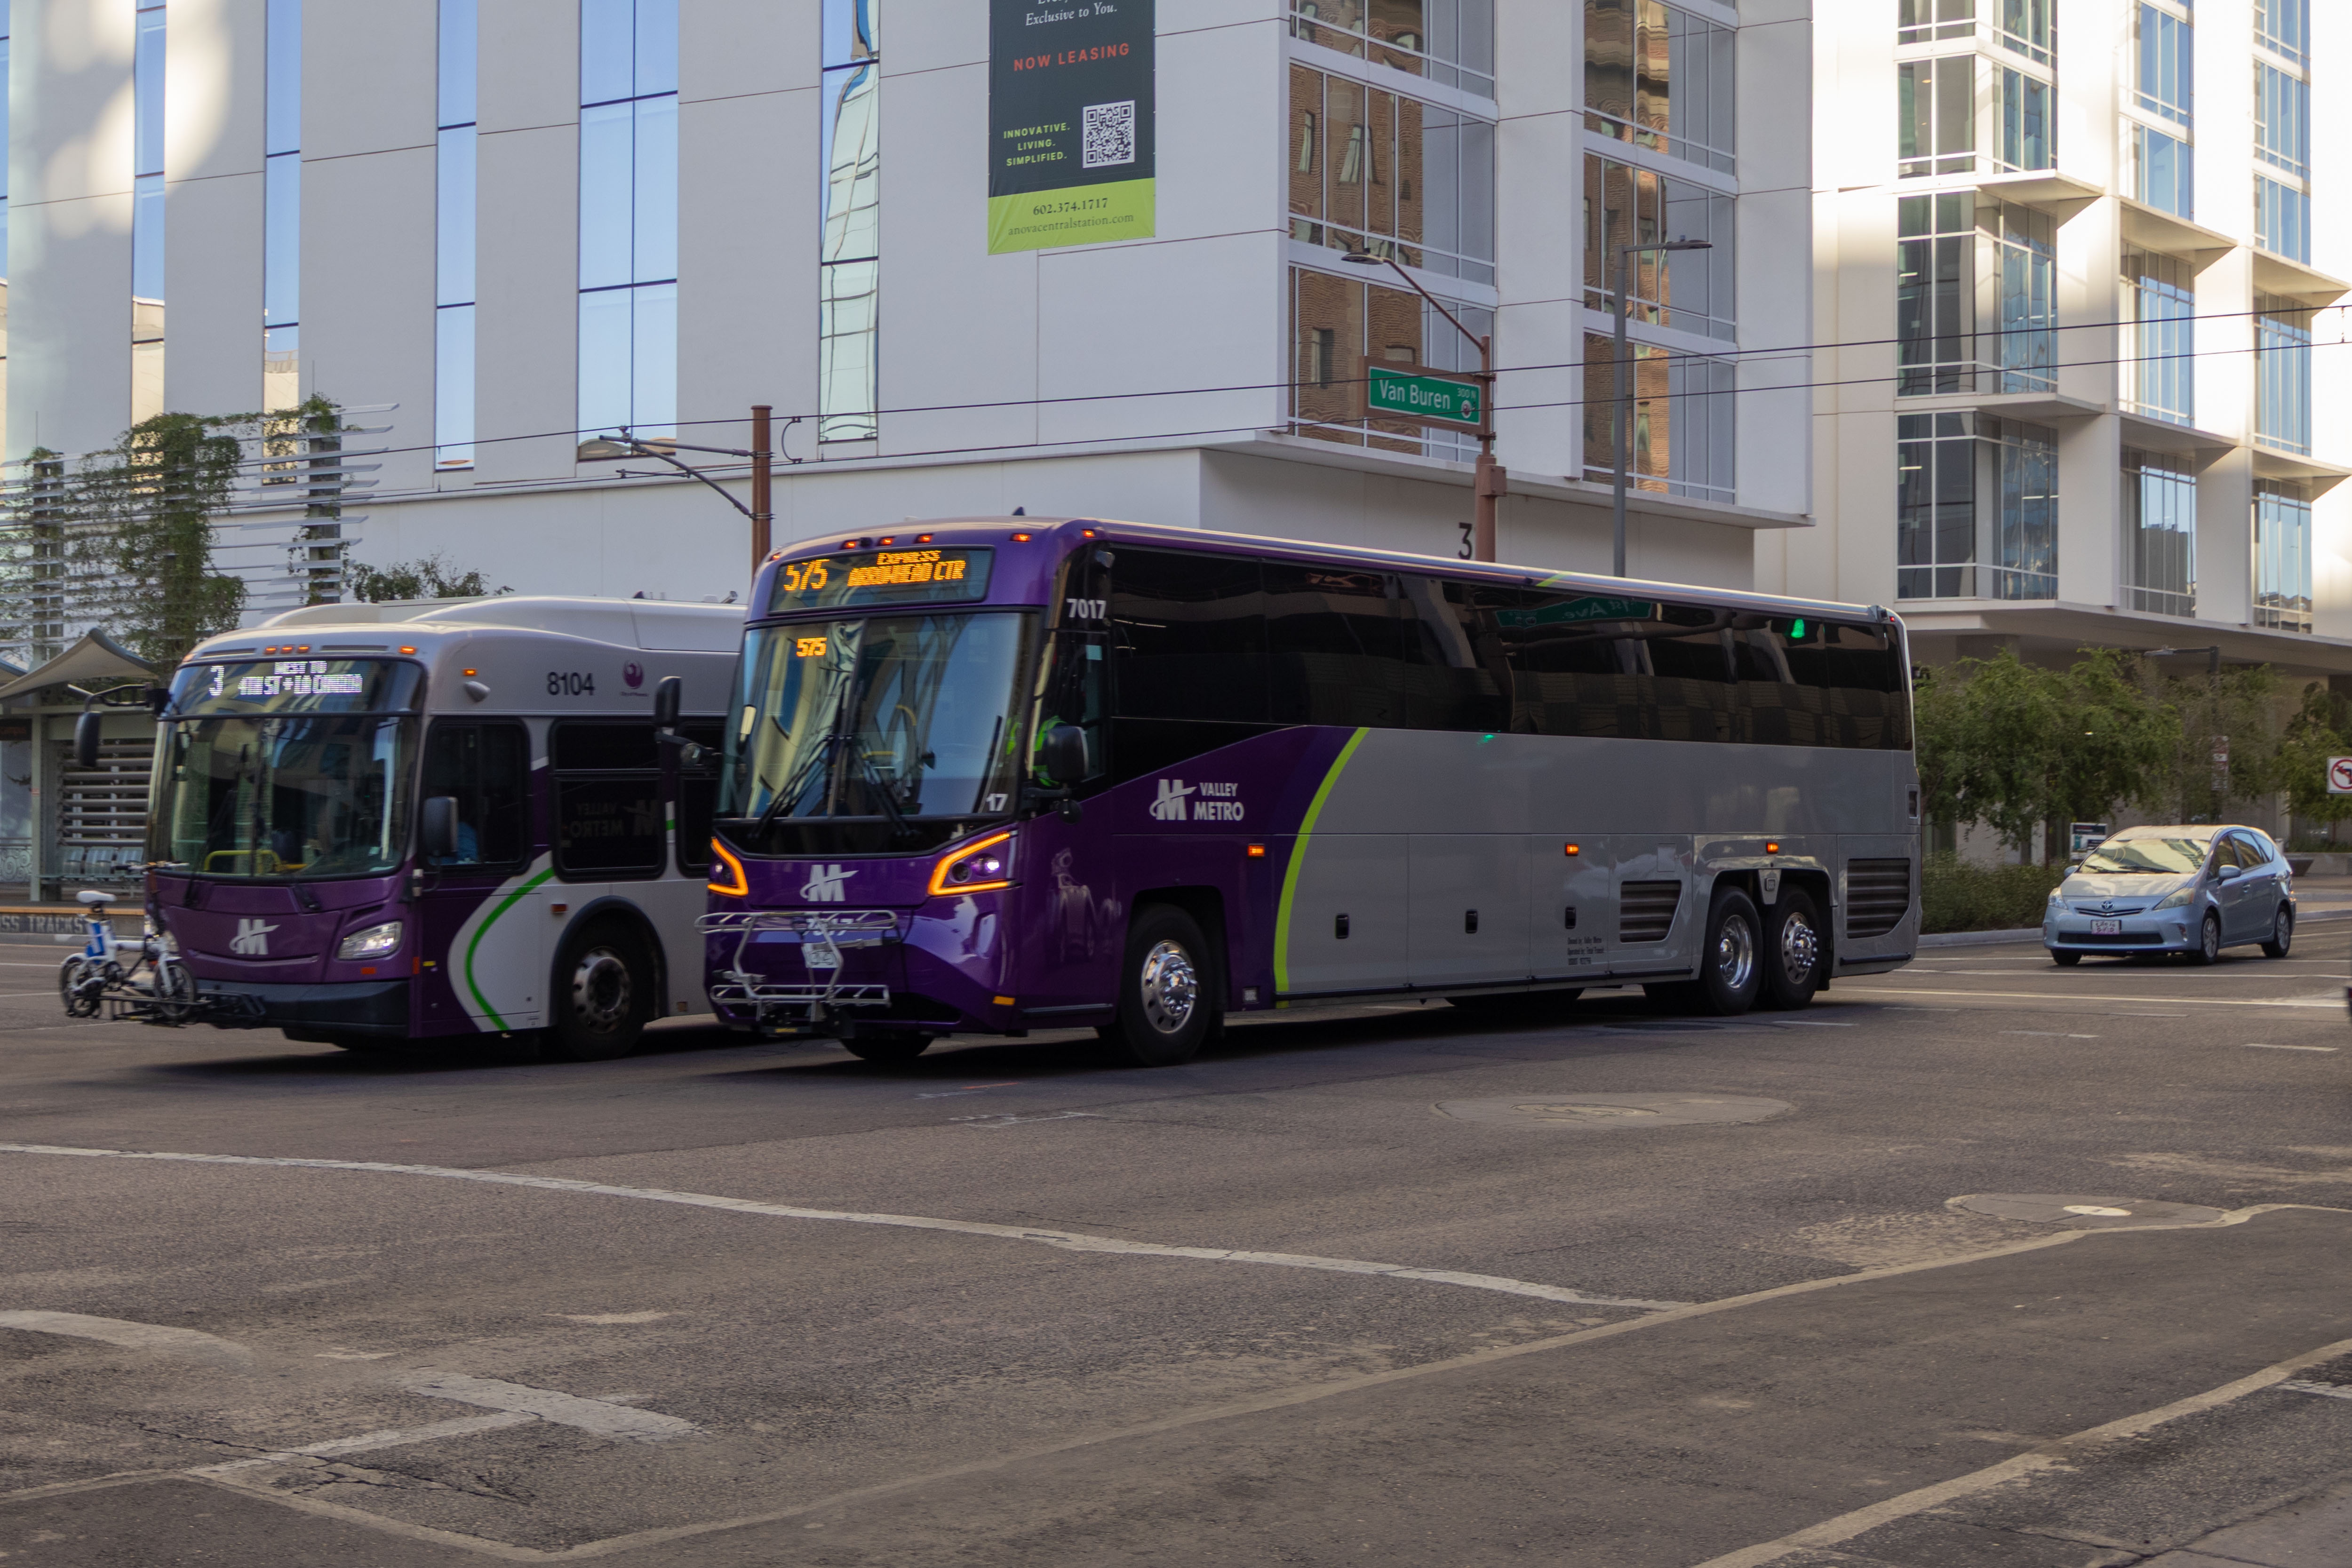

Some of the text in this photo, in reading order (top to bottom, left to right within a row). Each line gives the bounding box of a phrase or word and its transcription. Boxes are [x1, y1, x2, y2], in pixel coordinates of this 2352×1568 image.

[1025, 2, 1117, 26] Exclusive to You.
[1014, 43, 1130, 71] NOW LEASING
[1003, 122, 1070, 139] INNOVATIVE.
[1017, 139, 1056, 151] LIVING.
[1006, 151, 1067, 166] SIMPLIFIED.
[1033, 198, 1108, 215] 602.374.1717
[1008, 215, 1134, 235] anovacentralstation.com
[1379, 379, 1451, 409] Van Buren
[1458, 522, 1472, 560] 3
[783, 558, 830, 590] 575
[933, 560, 966, 580] CTR
[1066, 598, 1107, 619] 7017
[796, 637, 828, 657] 575
[209, 665, 224, 696] 3
[547, 671, 596, 696] 8104
[1199, 782, 1238, 796] VALLEY
[986, 793, 1009, 811] 17
[1193, 801, 1245, 821] METRO
